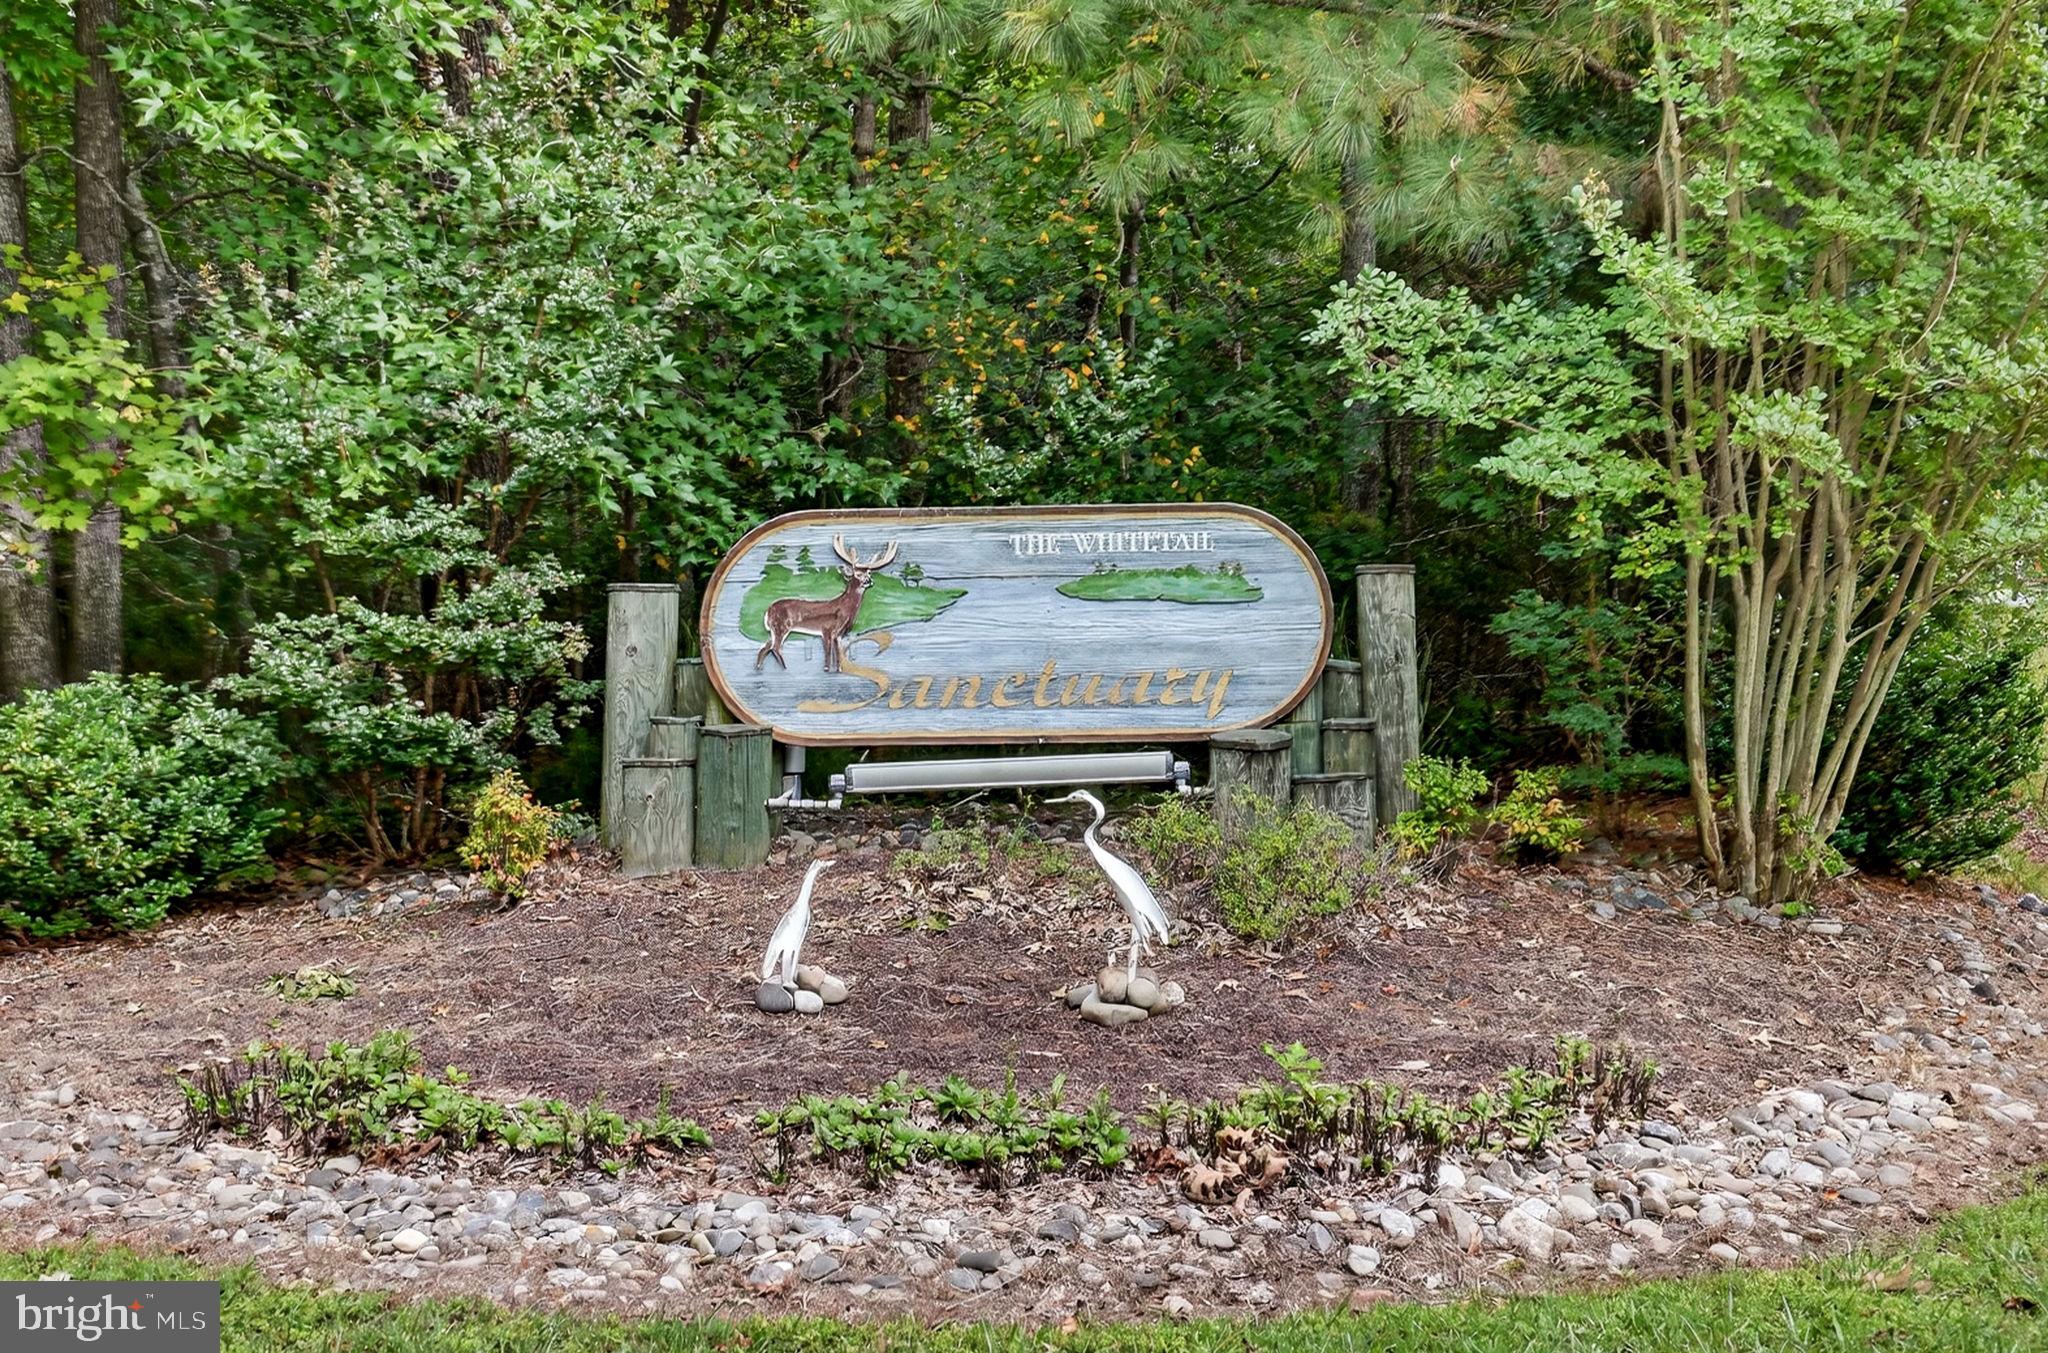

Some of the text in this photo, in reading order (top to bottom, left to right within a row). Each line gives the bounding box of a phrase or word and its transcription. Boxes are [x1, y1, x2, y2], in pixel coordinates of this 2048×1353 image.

[1008, 530, 1215, 556] THE WHITETAIL
[797, 631, 1234, 720] Sanctuary
